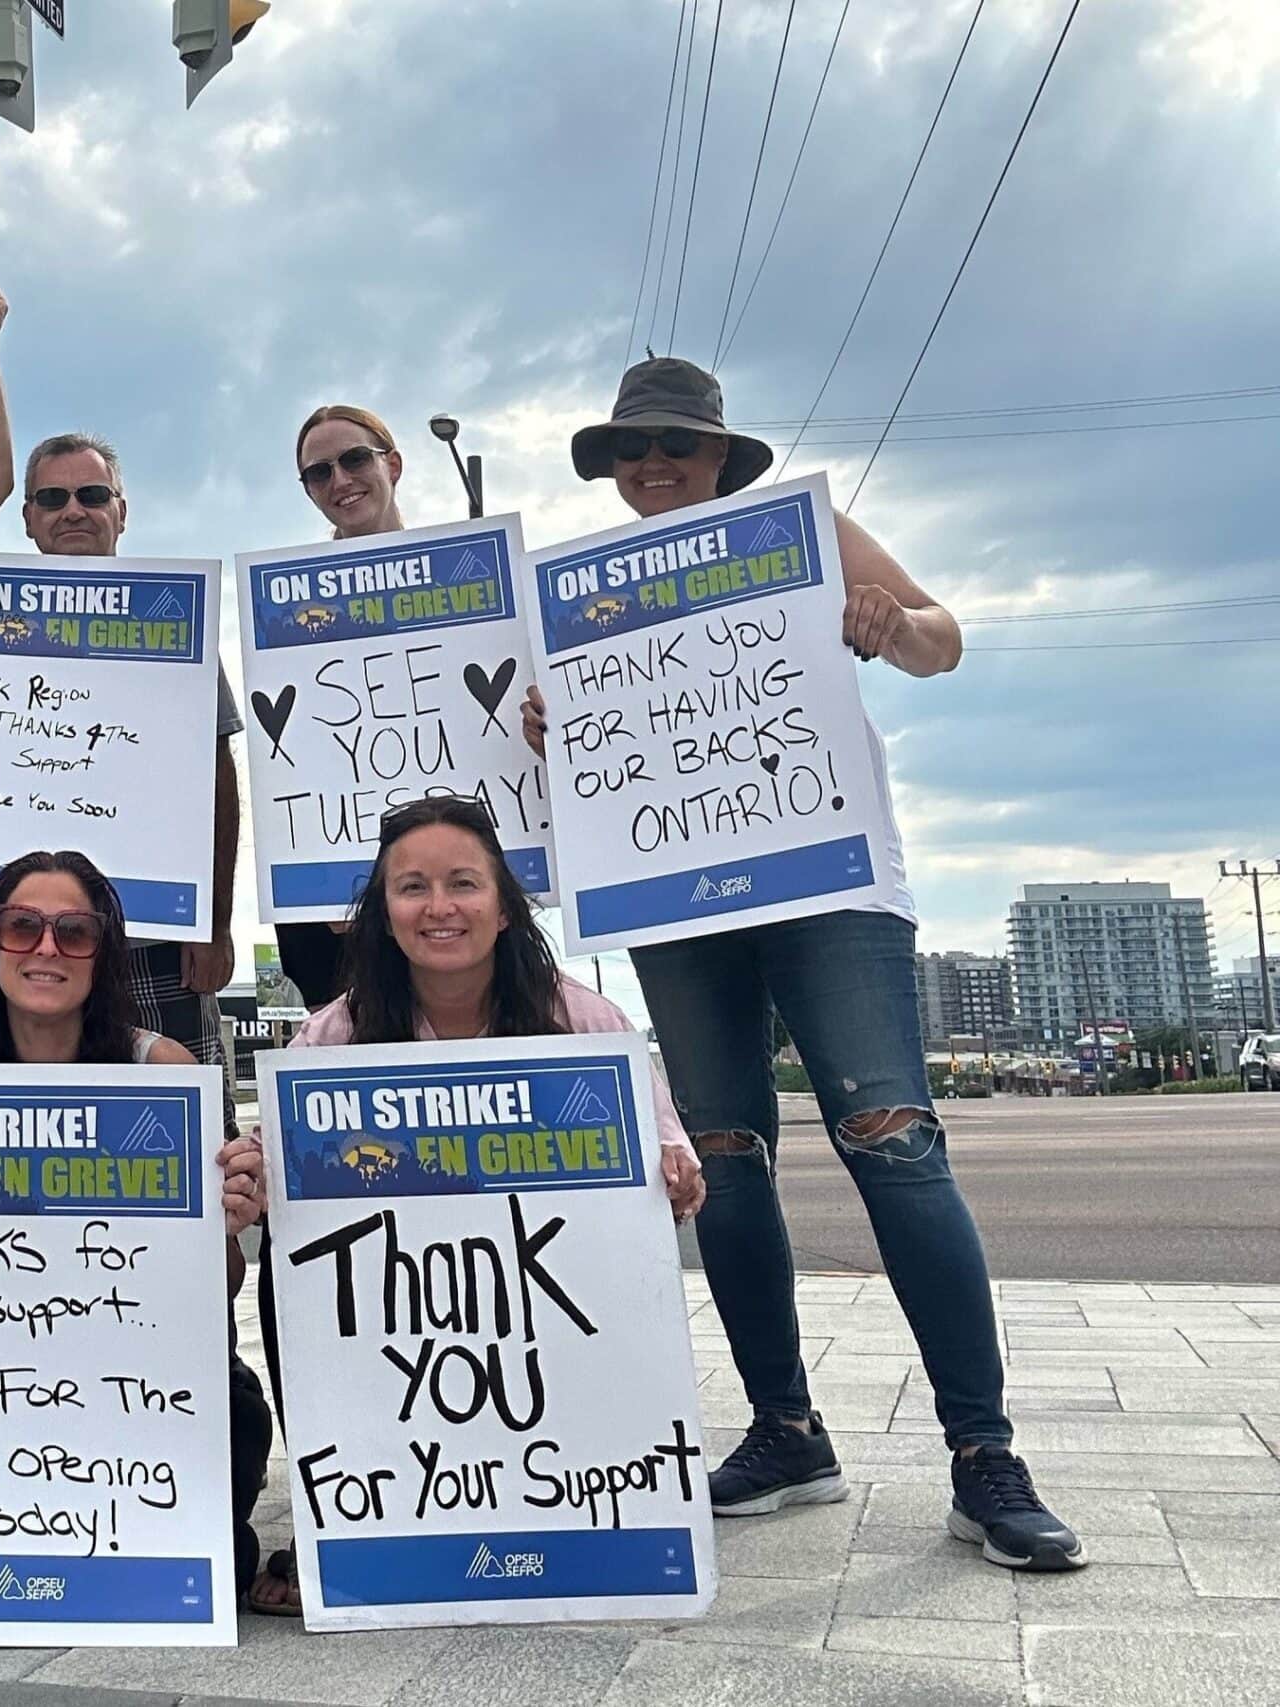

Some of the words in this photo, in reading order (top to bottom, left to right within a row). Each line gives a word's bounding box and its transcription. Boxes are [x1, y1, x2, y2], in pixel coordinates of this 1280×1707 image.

[270, 574, 310, 604] ON
[319, 555, 431, 597] STRIKE!
[557, 565, 598, 601] ON
[607, 528, 728, 587] STRIKE!
[639, 582, 677, 611] EN
[685, 548, 800, 599] GRÈVE!
[20, 584, 131, 615] STRIKE!
[348, 596, 384, 625] EN
[392, 580, 497, 622] GRÈVE!
[46, 618, 81, 647] EN
[88, 614, 187, 651] GRÈVE!
[312, 645, 442, 726] SEE
[549, 632, 687, 702] THANK
[87, 723, 105, 750] 4
[562, 710, 636, 764] FOR
[648, 659, 804, 734] HAVING
[333, 719, 455, 783] YOU
[574, 753, 655, 799] OUR
[673, 707, 820, 774] BACKS,
[29, 792, 55, 812] You
[631, 751, 844, 852] ONTARIO!
[720, 874, 751, 888] OPSEU
[721, 884, 751, 897] SEFPO
[304, 1089, 362, 1132] ON
[374, 1080, 533, 1130] STRIKE!
[42, 1147, 180, 1199] GRÈVE!
[416, 1135, 467, 1177] EN
[480, 1121, 620, 1176] GRÈVE!
[76, 1220, 148, 1270] for
[289, 1193, 598, 1342] Thank
[102, 1376, 195, 1415] The
[382, 1337, 545, 1431] YOU
[297, 1444, 396, 1529] For
[409, 1441, 504, 1519] Your
[523, 1419, 701, 1529] Support
[27, 1577, 65, 1590] OPSEU
[505, 1553, 544, 1566] OPSEU
[505, 1564, 544, 1577] SEFPO
[26, 1588, 65, 1600] SEFPO
